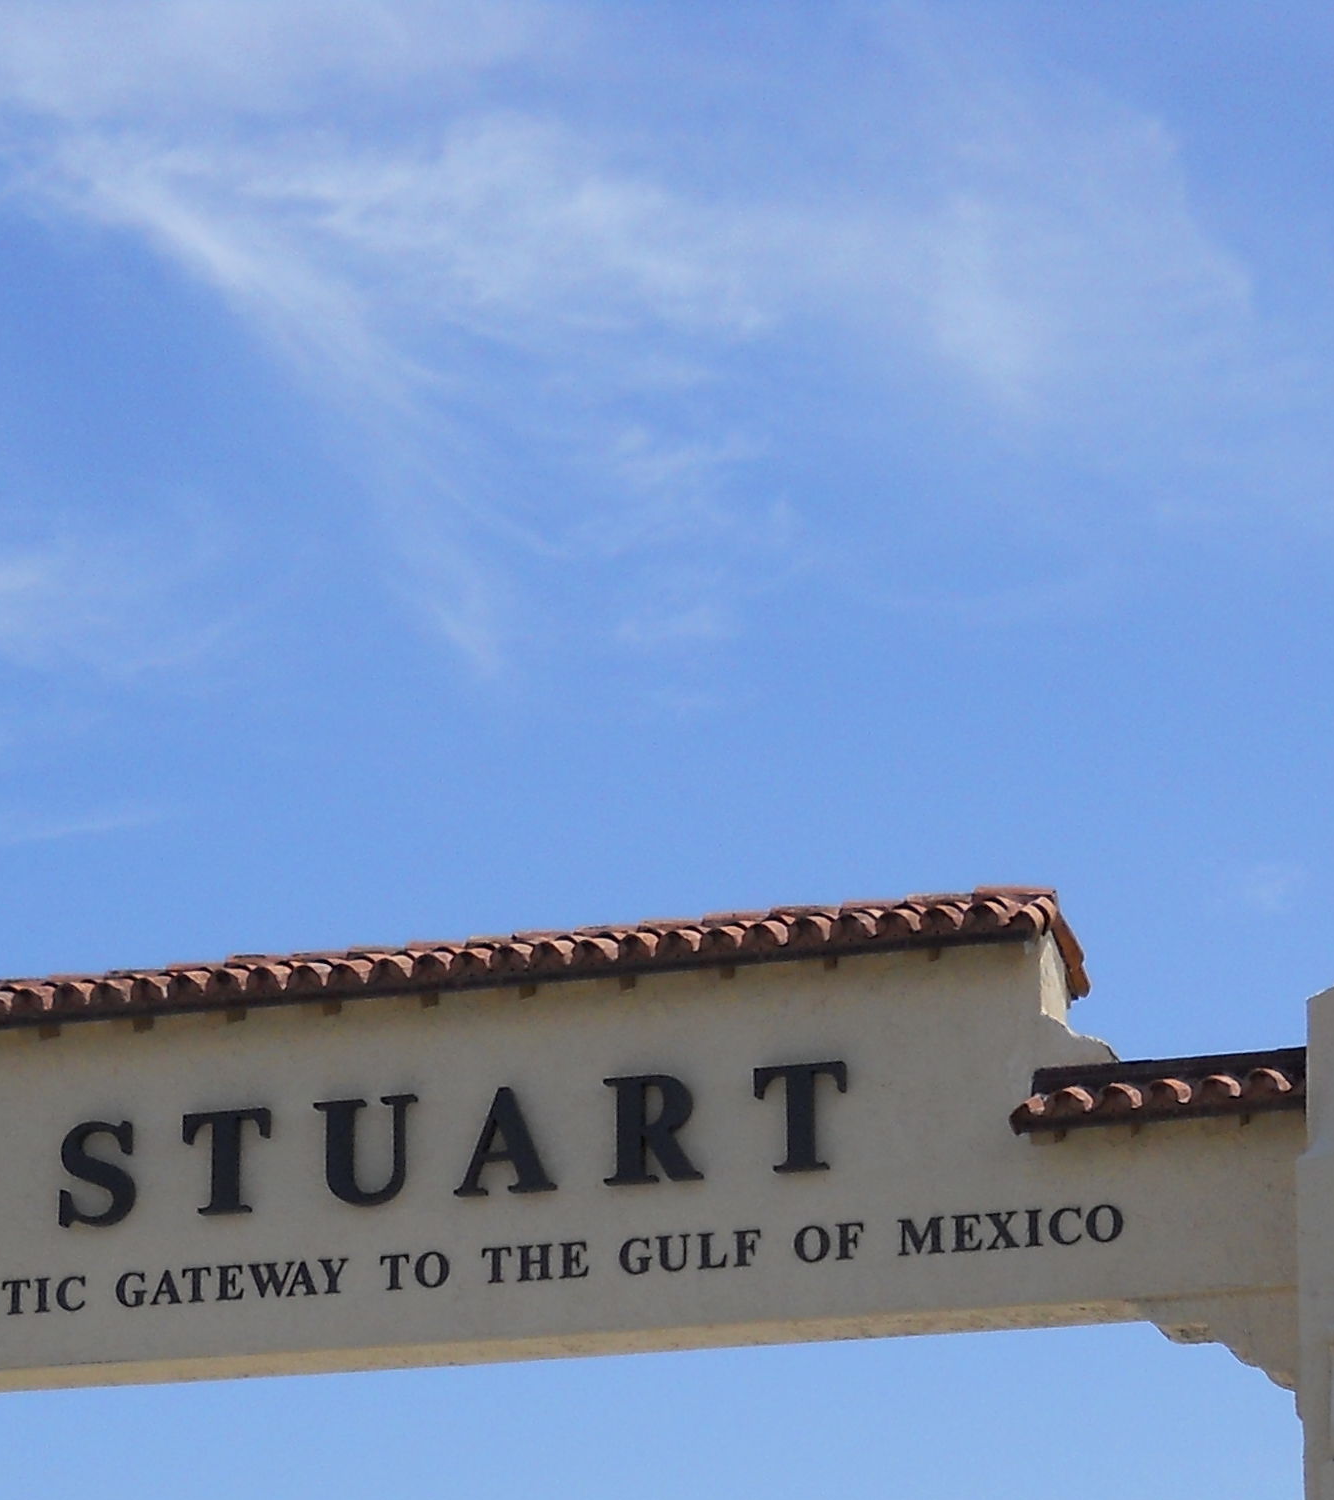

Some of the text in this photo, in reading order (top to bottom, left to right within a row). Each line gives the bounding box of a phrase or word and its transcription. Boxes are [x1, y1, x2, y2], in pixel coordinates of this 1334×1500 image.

[58, 1060, 848, 1228] STUART
[115, 1257, 349, 1309] GATEWAY
[379, 1250, 450, 1292] TO
[481, 1240, 590, 1285] THE
[618, 1228, 762, 1276] GULF
[793, 1221, 865, 1264] OF
[897, 1203, 1125, 1257] MEXICO
